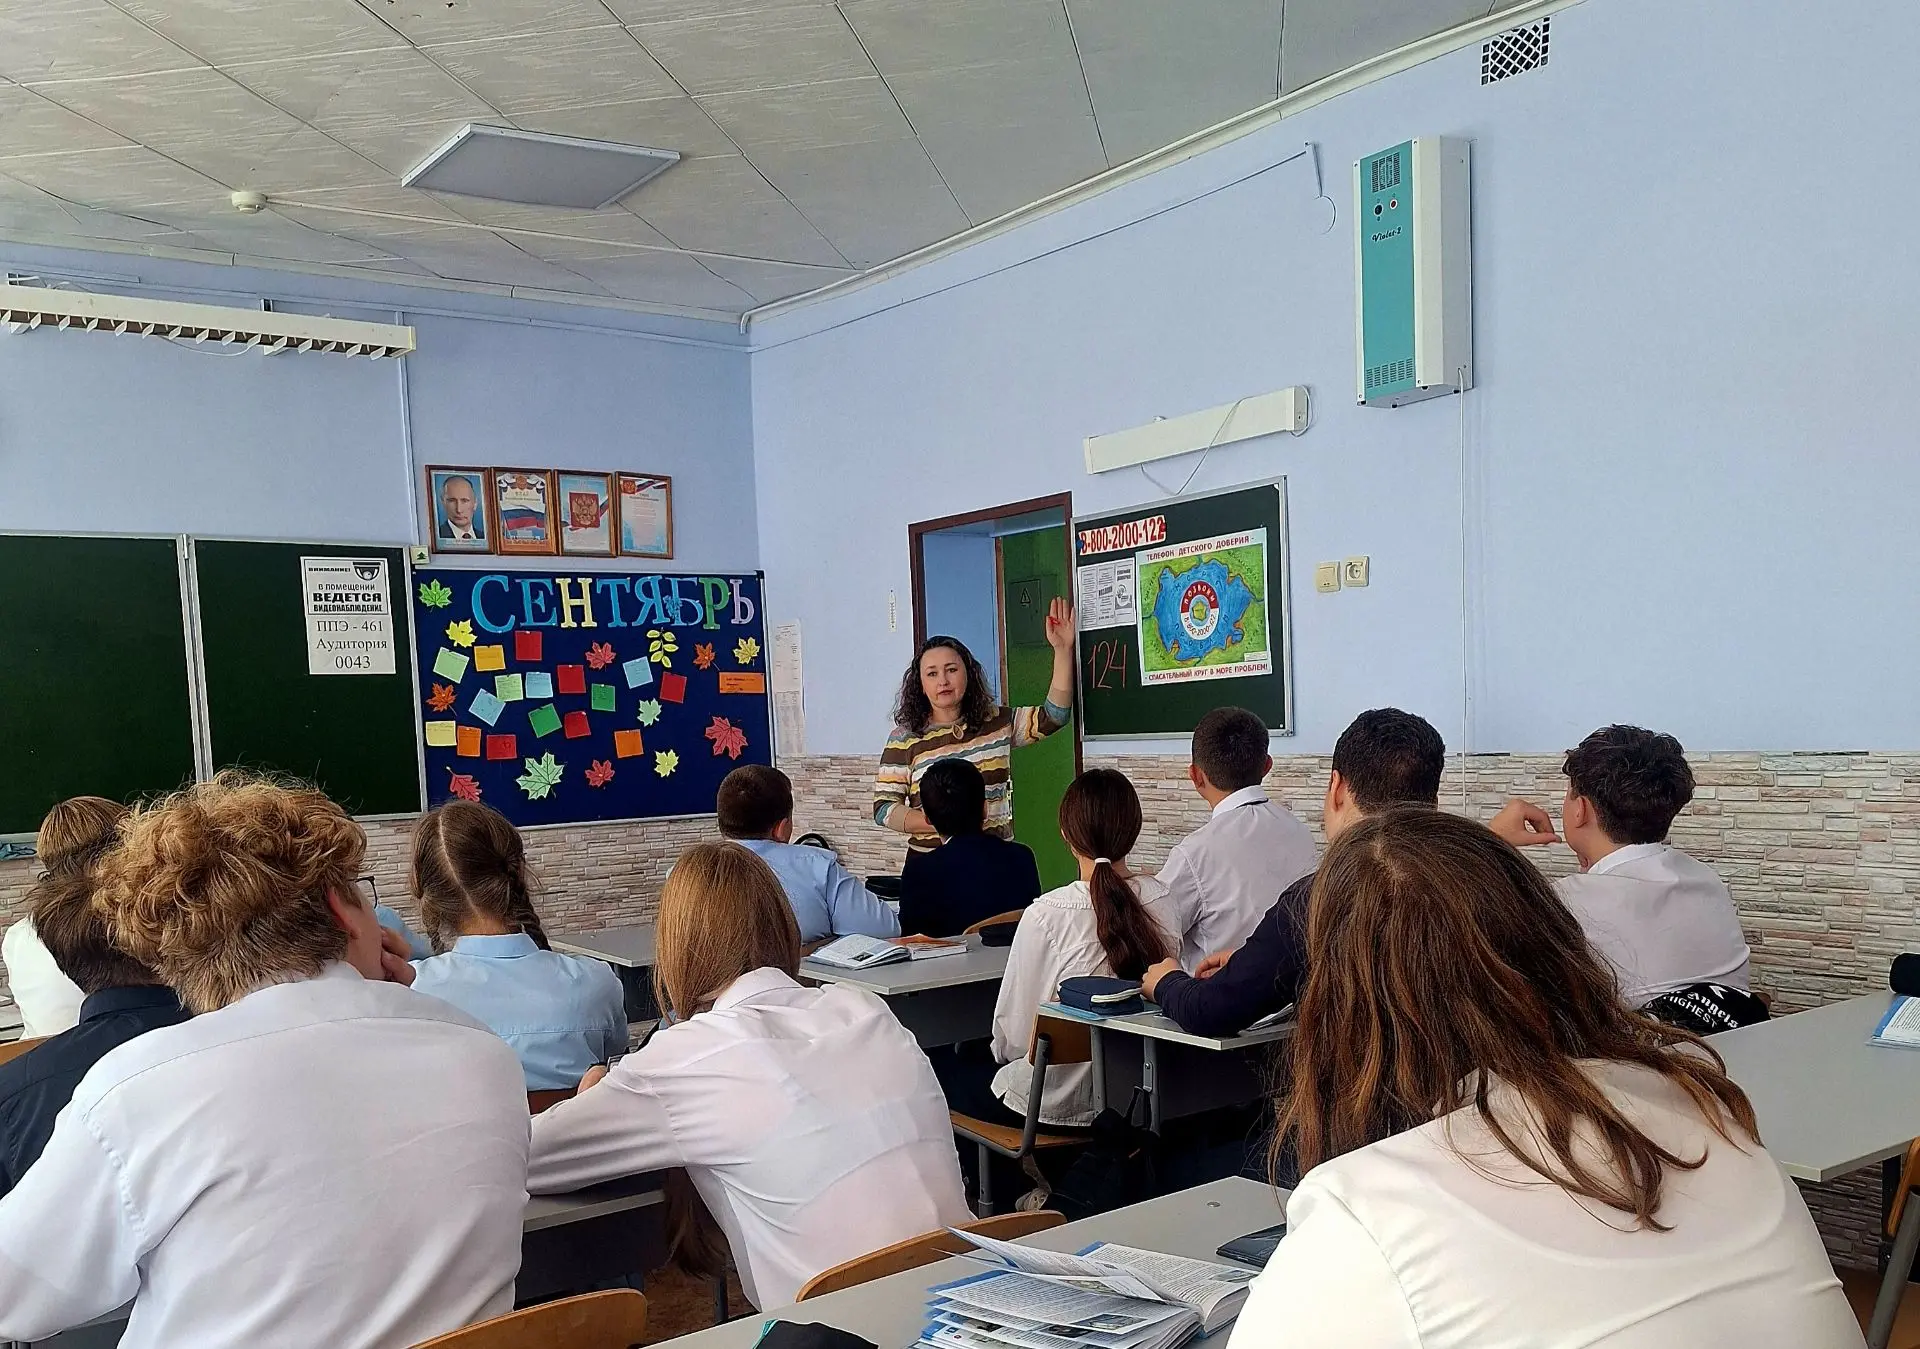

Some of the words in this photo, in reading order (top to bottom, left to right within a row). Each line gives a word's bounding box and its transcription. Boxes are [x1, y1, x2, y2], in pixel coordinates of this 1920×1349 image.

[1080, 516, 1165, 554] 8-800-2000-122
[1146, 550, 1174, 561] ТЕЛЕФОН
[1178, 543, 1212, 557] ДЕТСКОГО
[1216, 535, 1249, 549] ДОВЕРИЯ
[313, 592, 382, 603] ВЕДЕТСЯ
[471, 574, 755, 634] СЕНТЯБРЬ
[313, 604, 383, 612] ВИДЕОНАБЛЮДЕНИЕ
[316, 620, 349, 632] ППЭ
[361, 620, 383, 632] 461
[316, 638, 388, 652] Аудитория
[335, 655, 371, 669] 0043
[1088, 639, 1127, 689] 124
[1149, 669, 1193, 681] СПАСАТЕЛЬНЫЙ
[1194, 669, 1208, 677] КРУГ
[1210, 668, 1214, 676] В
[1216, 666, 1232, 674] МОРЕ
[1235, 663, 1268, 673] ПРОБЛЕМ!
